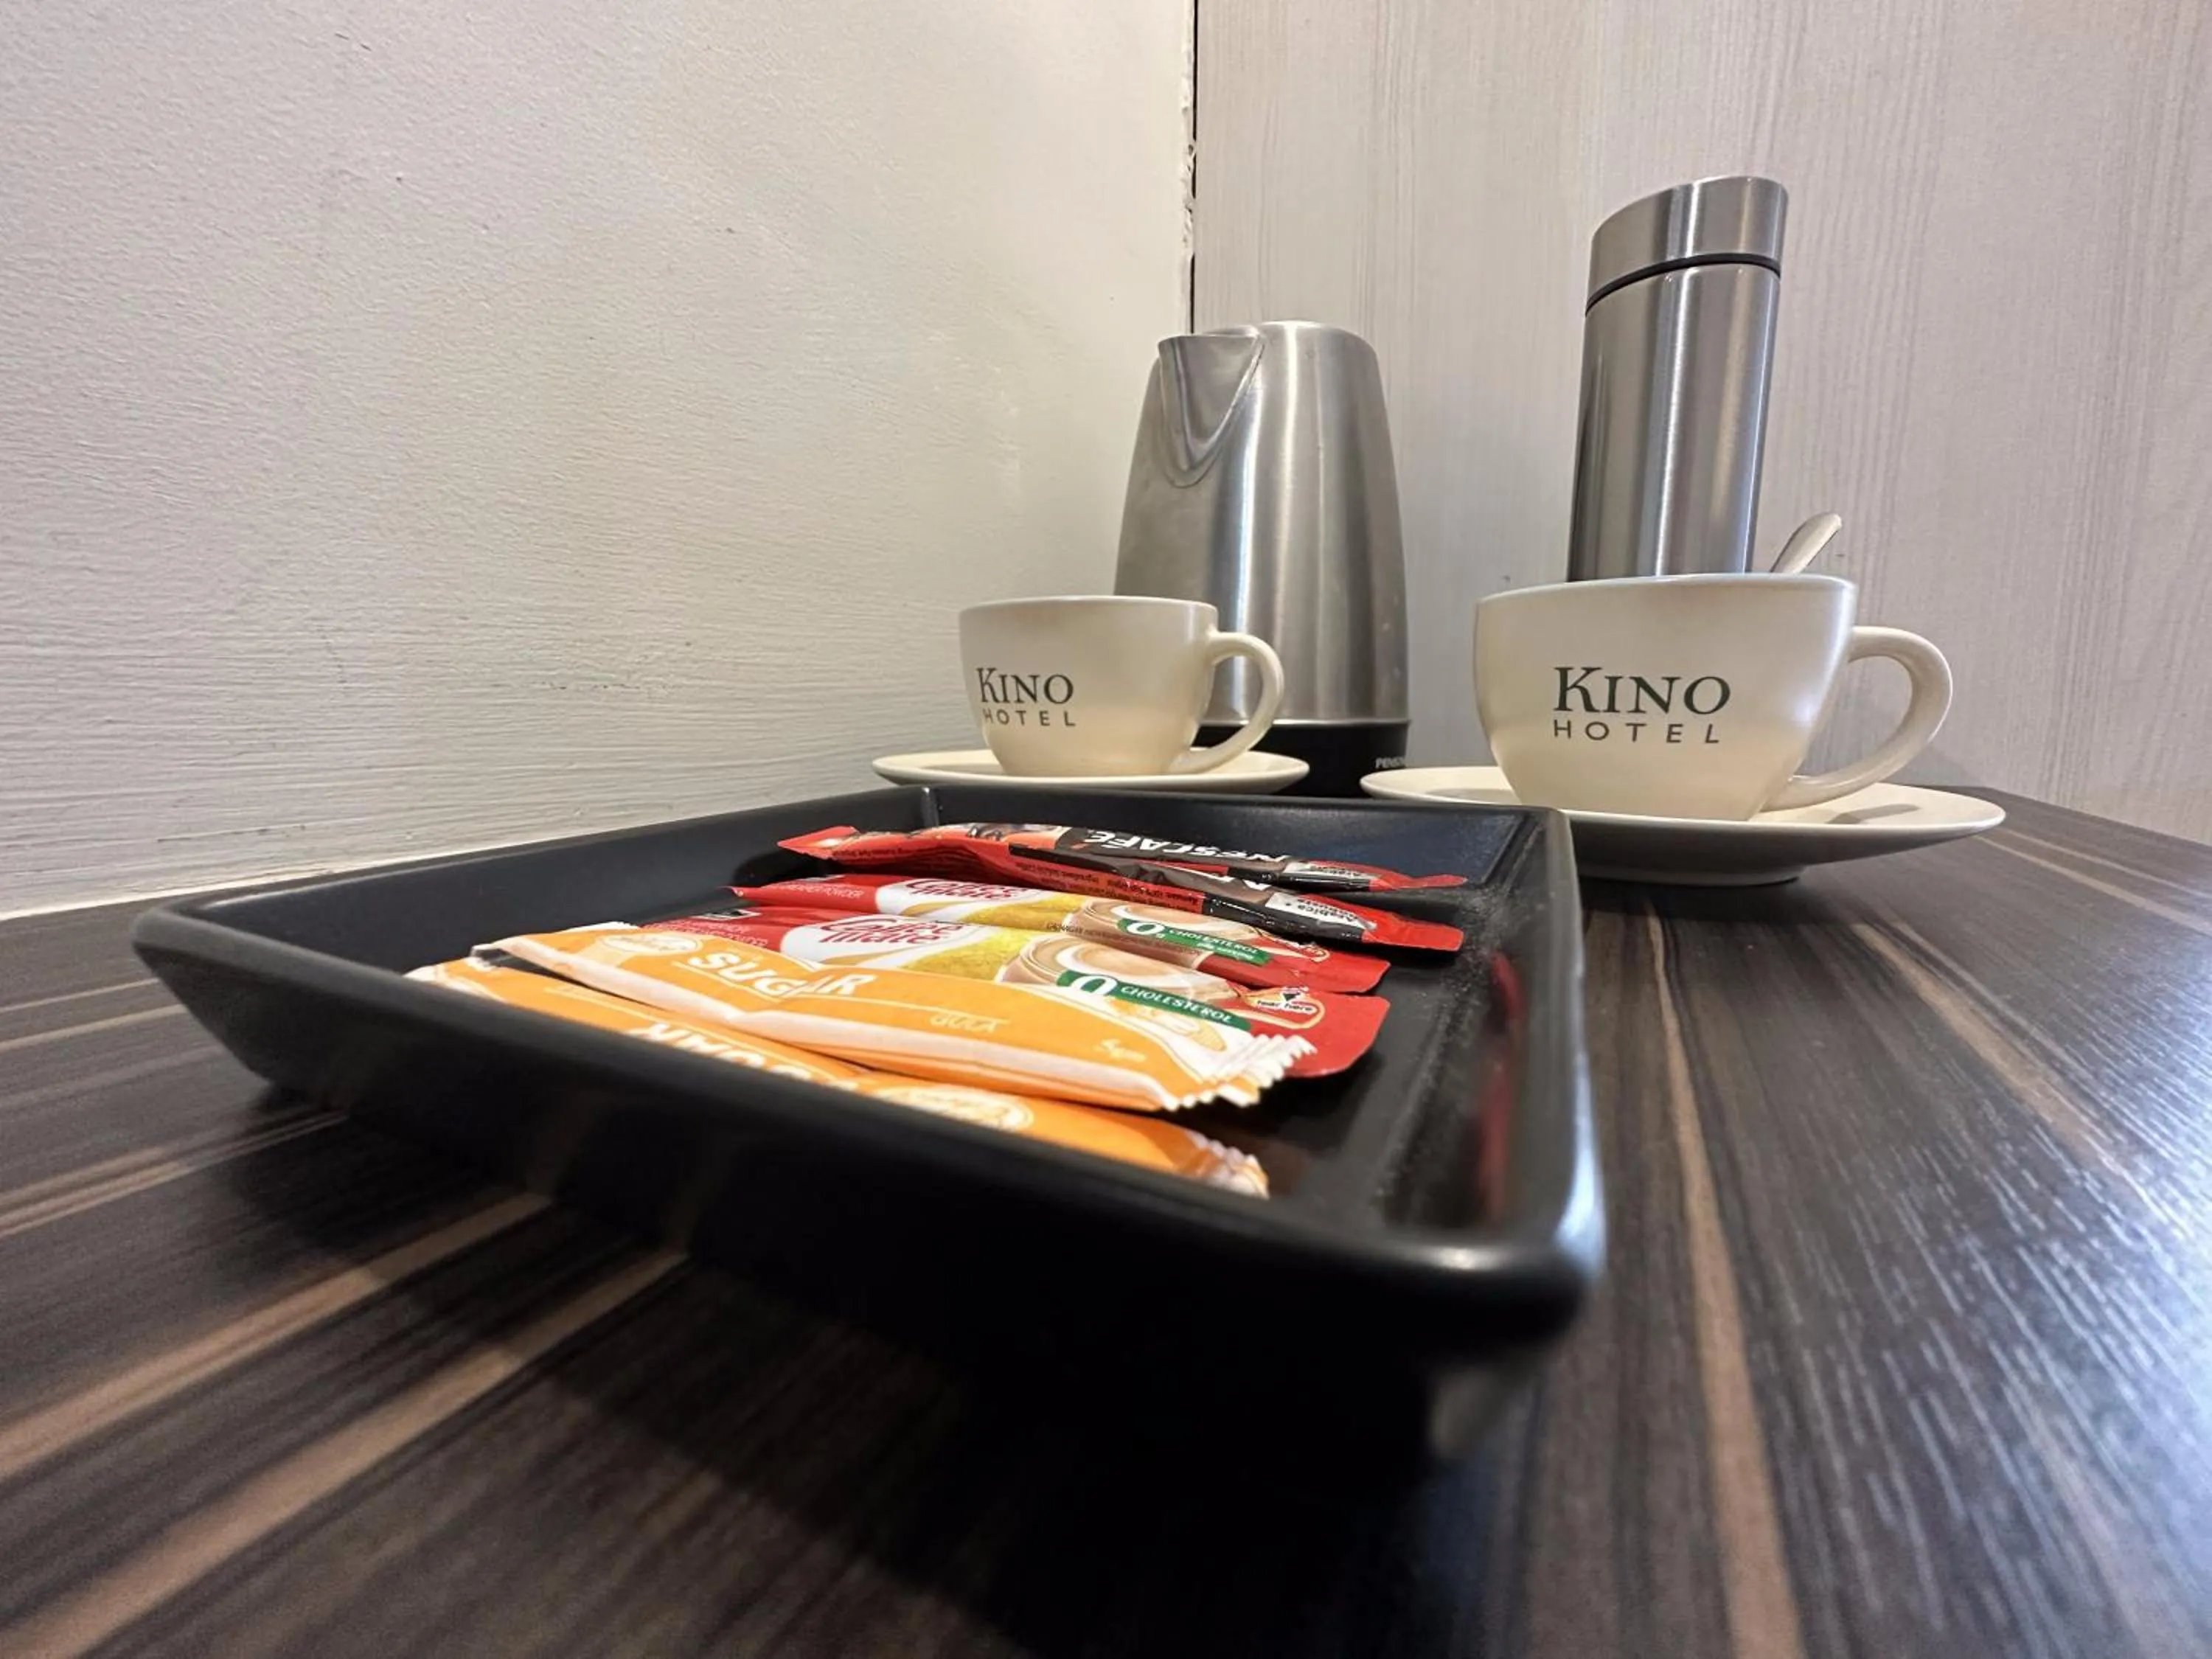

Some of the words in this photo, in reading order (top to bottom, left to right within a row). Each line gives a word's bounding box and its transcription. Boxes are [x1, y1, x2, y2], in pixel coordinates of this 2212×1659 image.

[976, 667, 1074, 706] KINO
[1552, 666, 1731, 715] KINO
[982, 707, 1077, 728] HOTEL
[1553, 720, 1720, 744] HOTEL
[1119, 984, 1235, 1026] CHOLESTEROL
